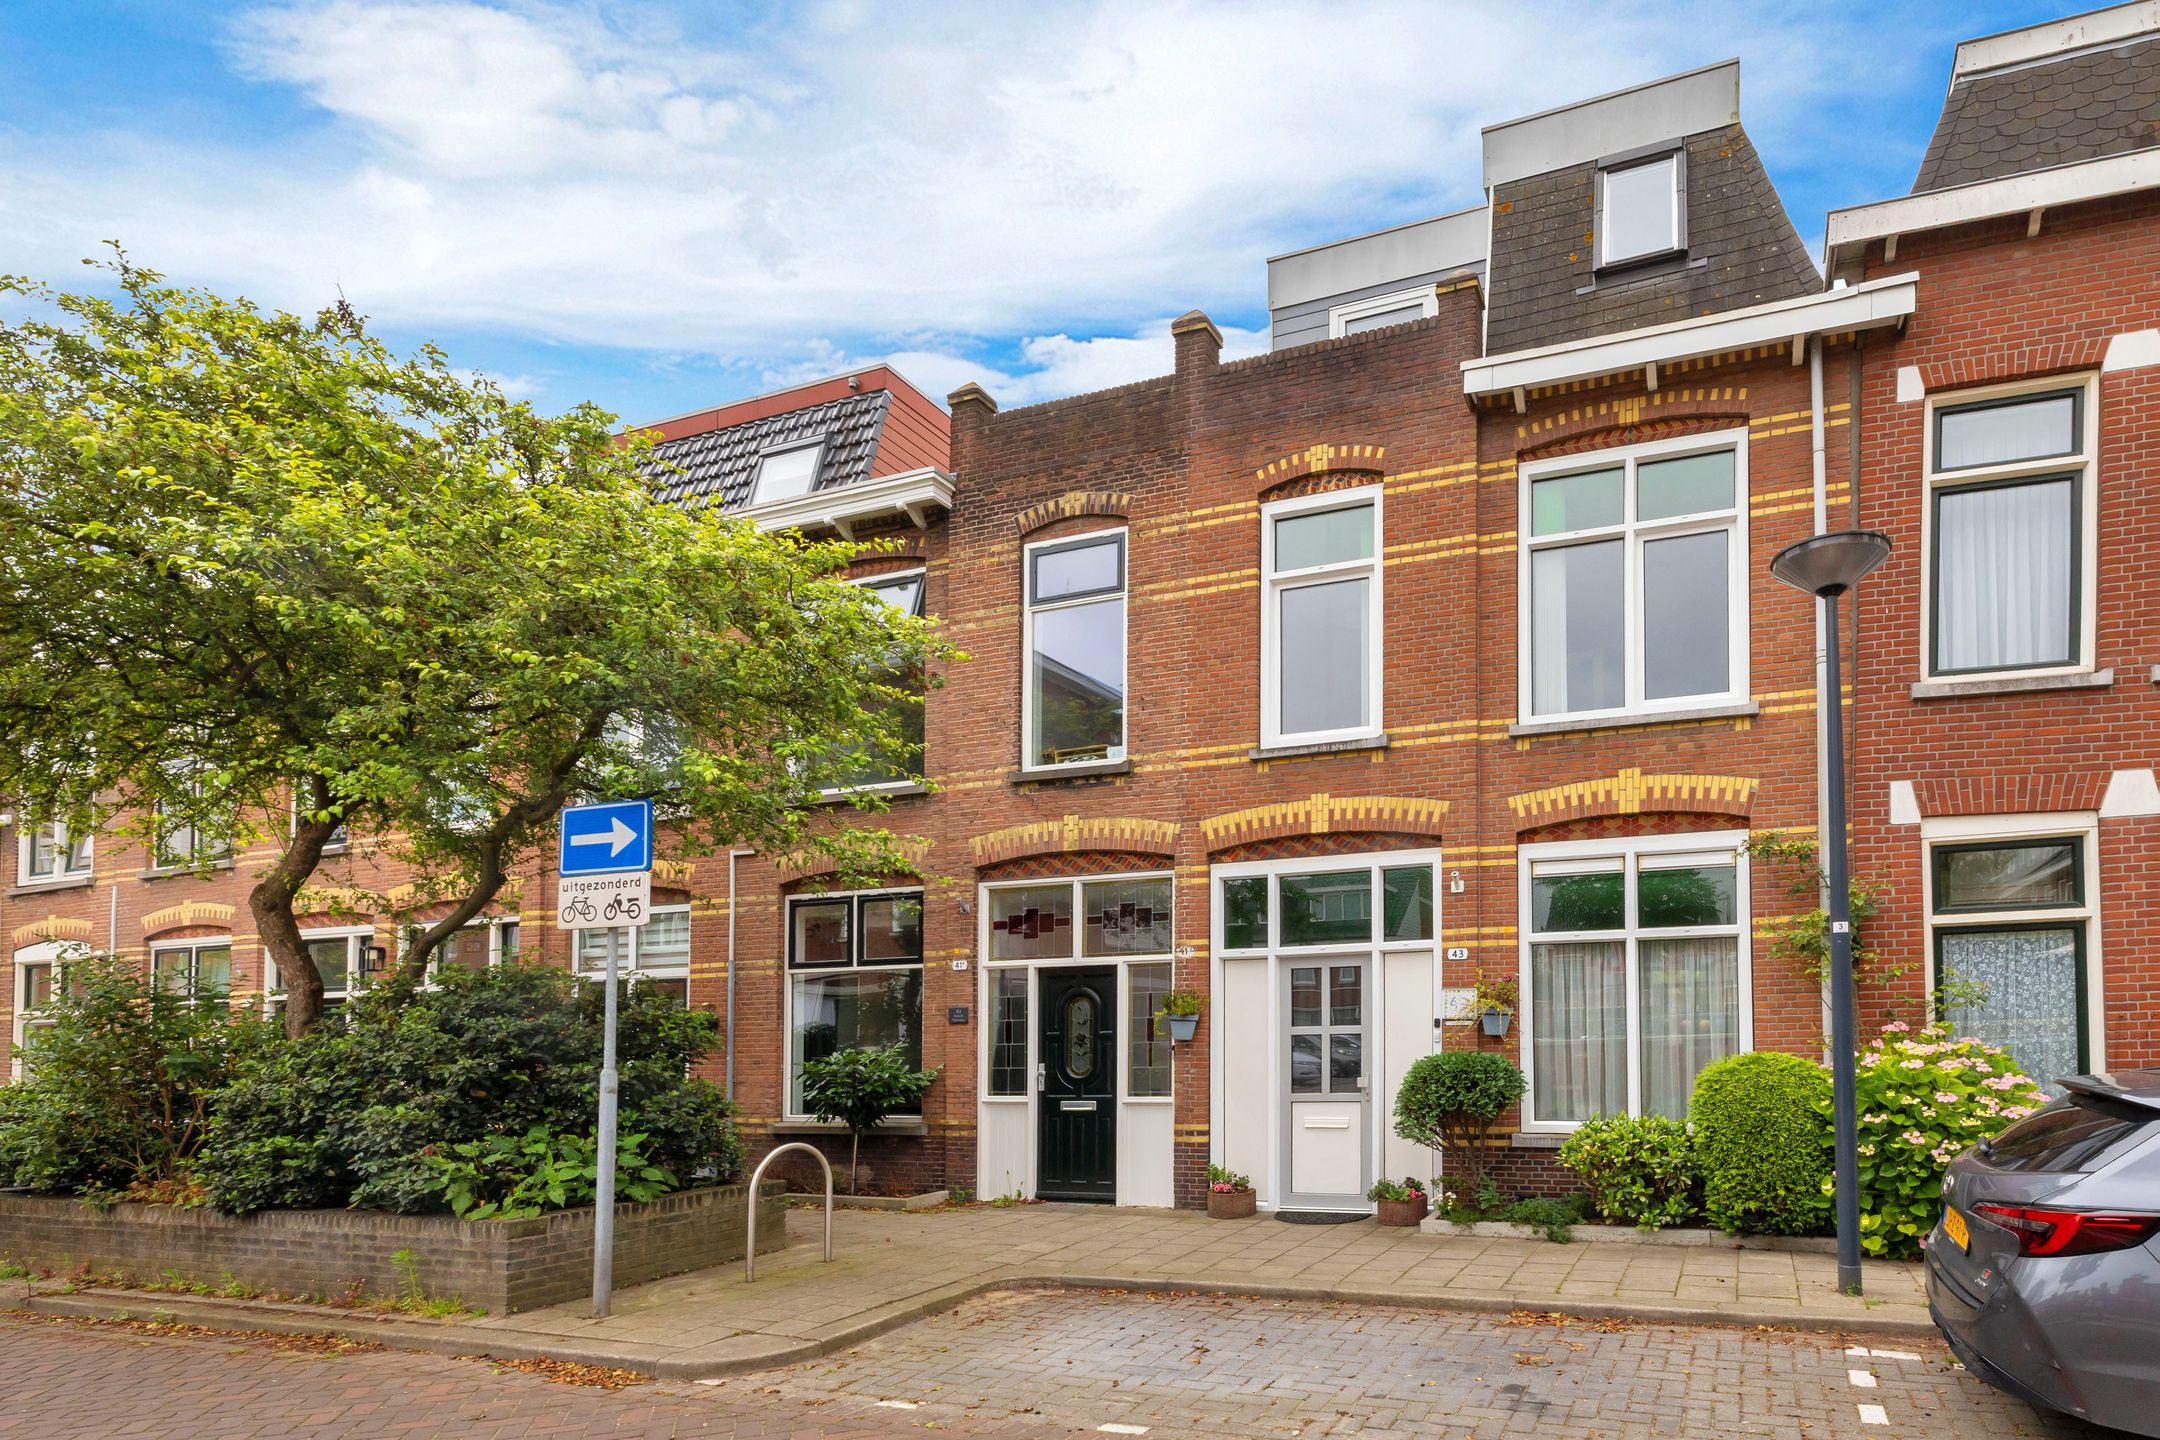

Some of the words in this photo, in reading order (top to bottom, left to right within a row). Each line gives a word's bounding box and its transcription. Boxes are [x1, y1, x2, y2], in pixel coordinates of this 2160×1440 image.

[562, 877, 641, 894] uitgezonderd
[1838, 922, 1843, 930] 3
[1452, 949, 1464, 958] 43
